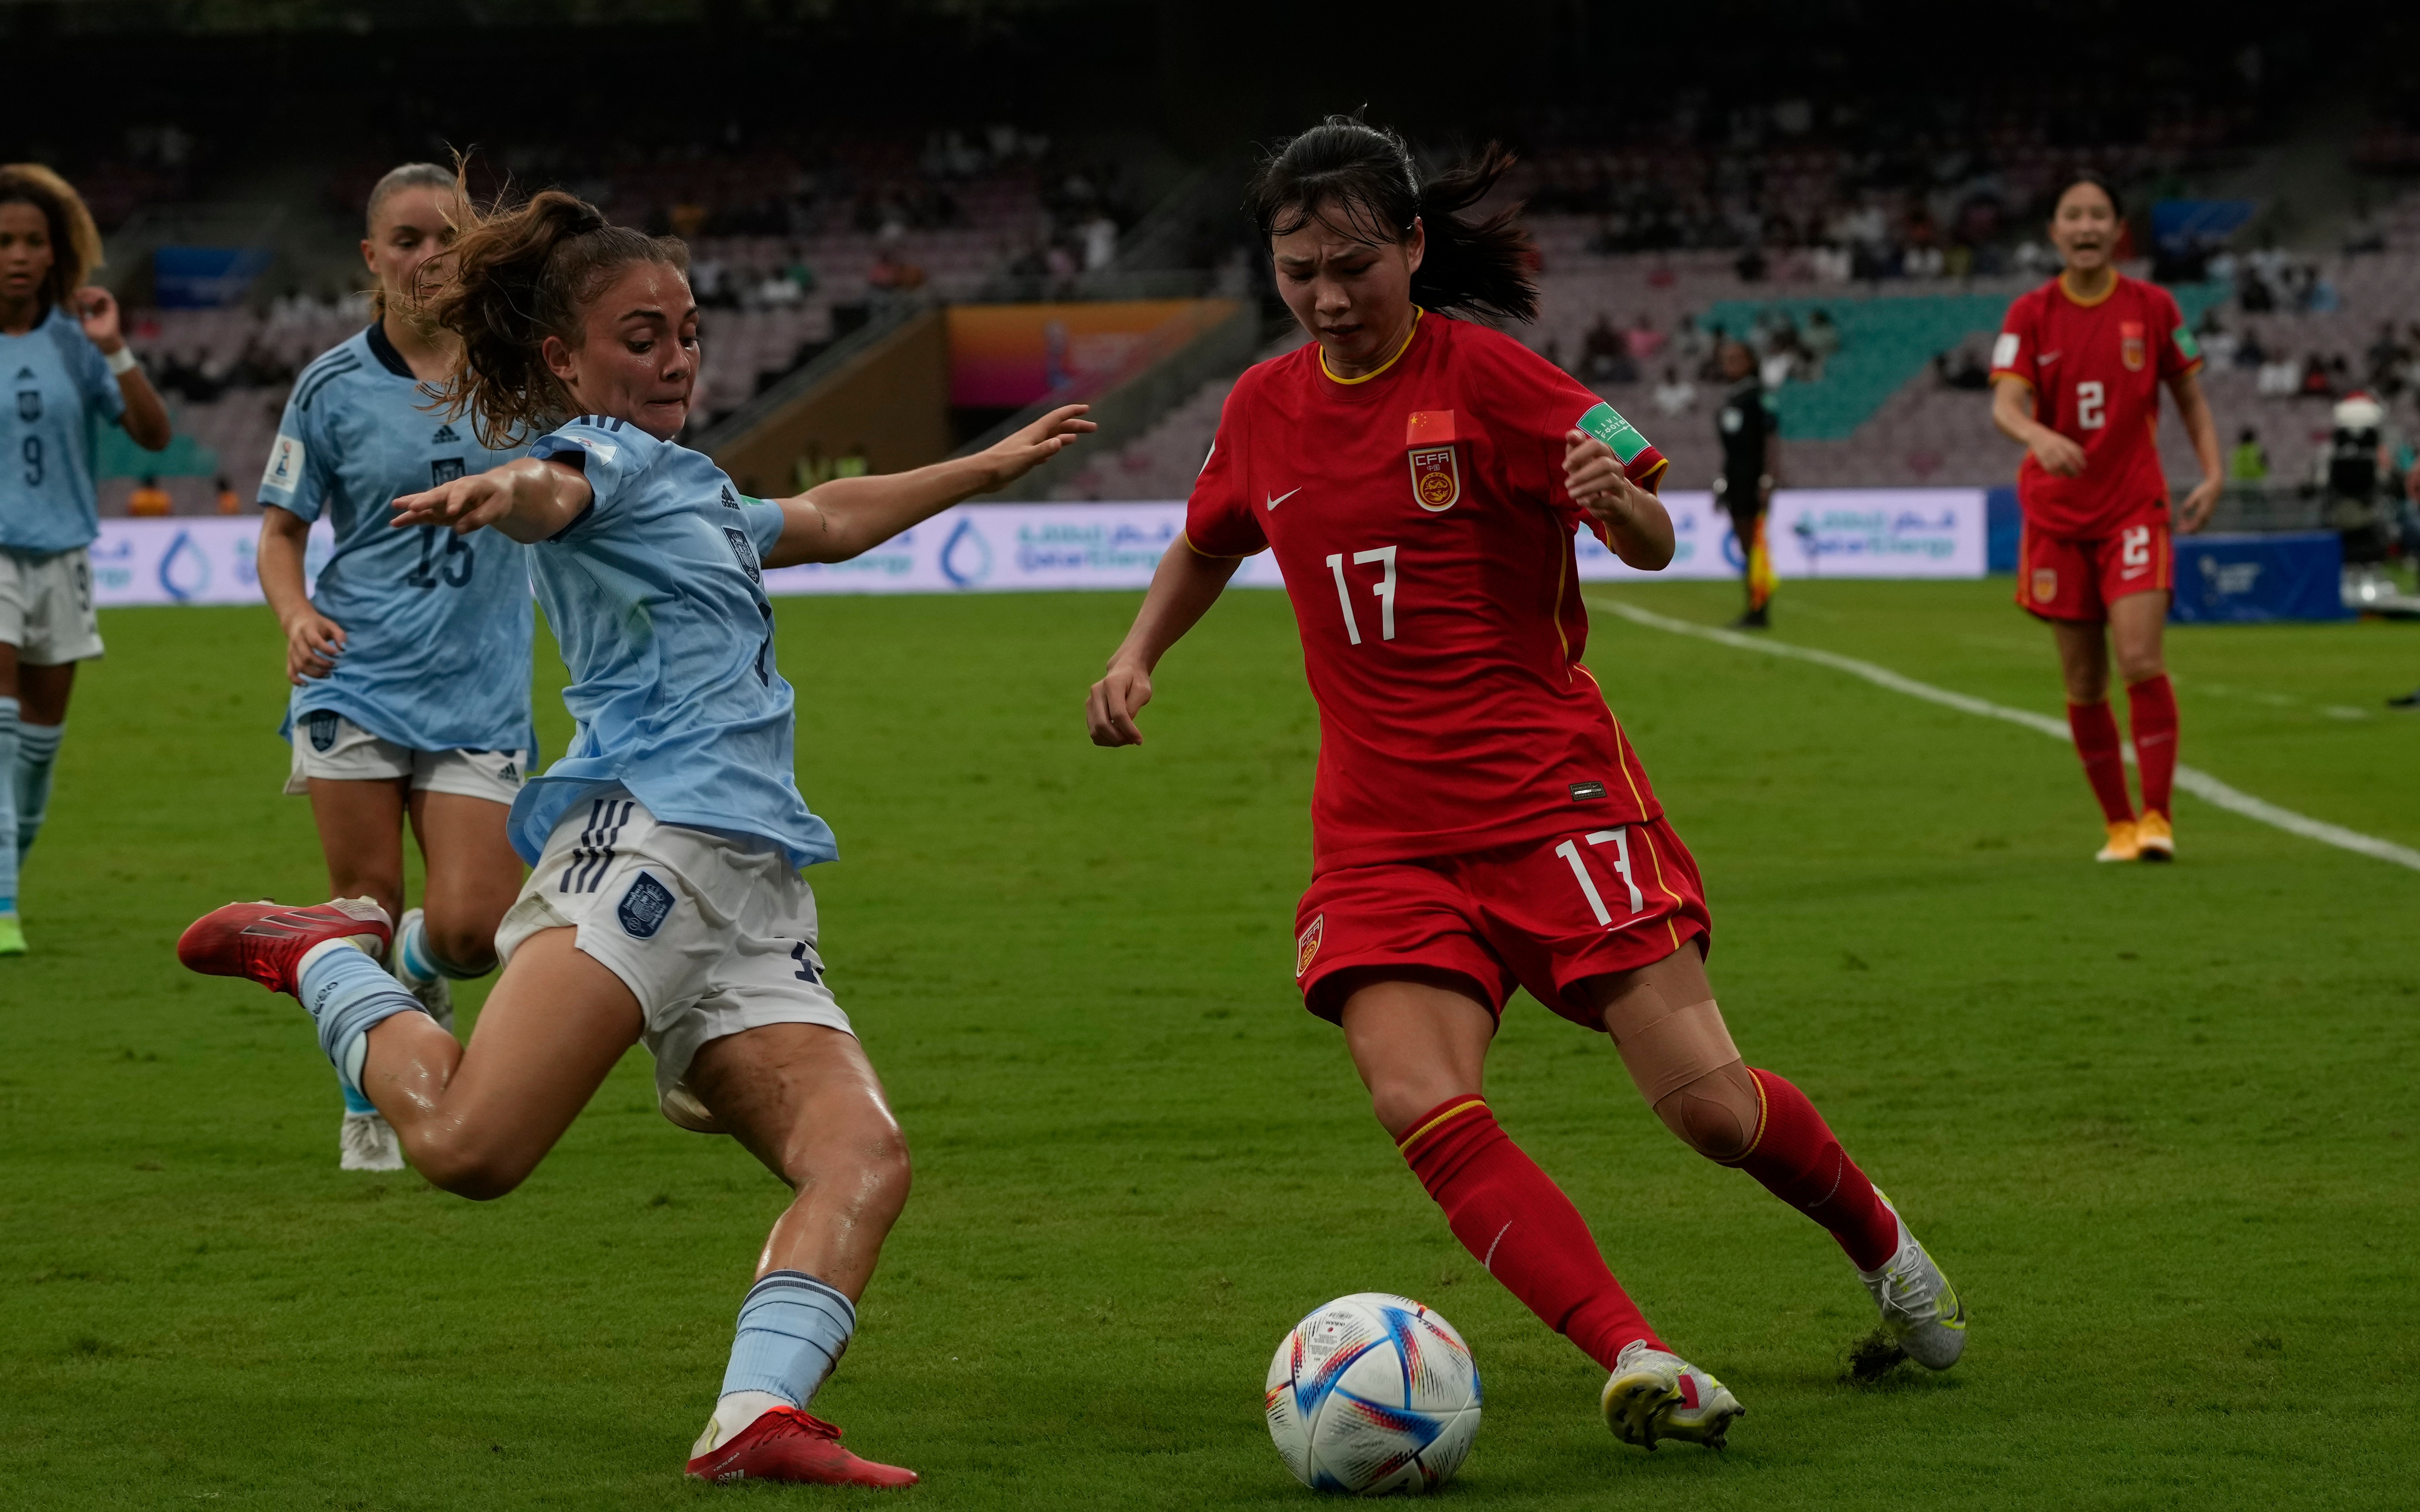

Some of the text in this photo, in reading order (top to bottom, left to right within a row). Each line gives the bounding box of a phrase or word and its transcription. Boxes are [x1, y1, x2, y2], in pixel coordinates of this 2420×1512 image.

[2076, 380, 2106, 430] 2
[23, 435, 42, 487] 9
[1415, 452, 1449, 466] CFA
[1427, 464, 1440, 472] 中国
[721, 500, 740, 510] adidas
[409, 524, 474, 589] 15
[1017, 547, 1163, 571] QatarEnerg
[2121, 524, 2151, 566] 2
[1326, 545, 1397, 645] 17
[1555, 825, 1643, 927] 17
[1301, 922, 1320, 948] CFA
